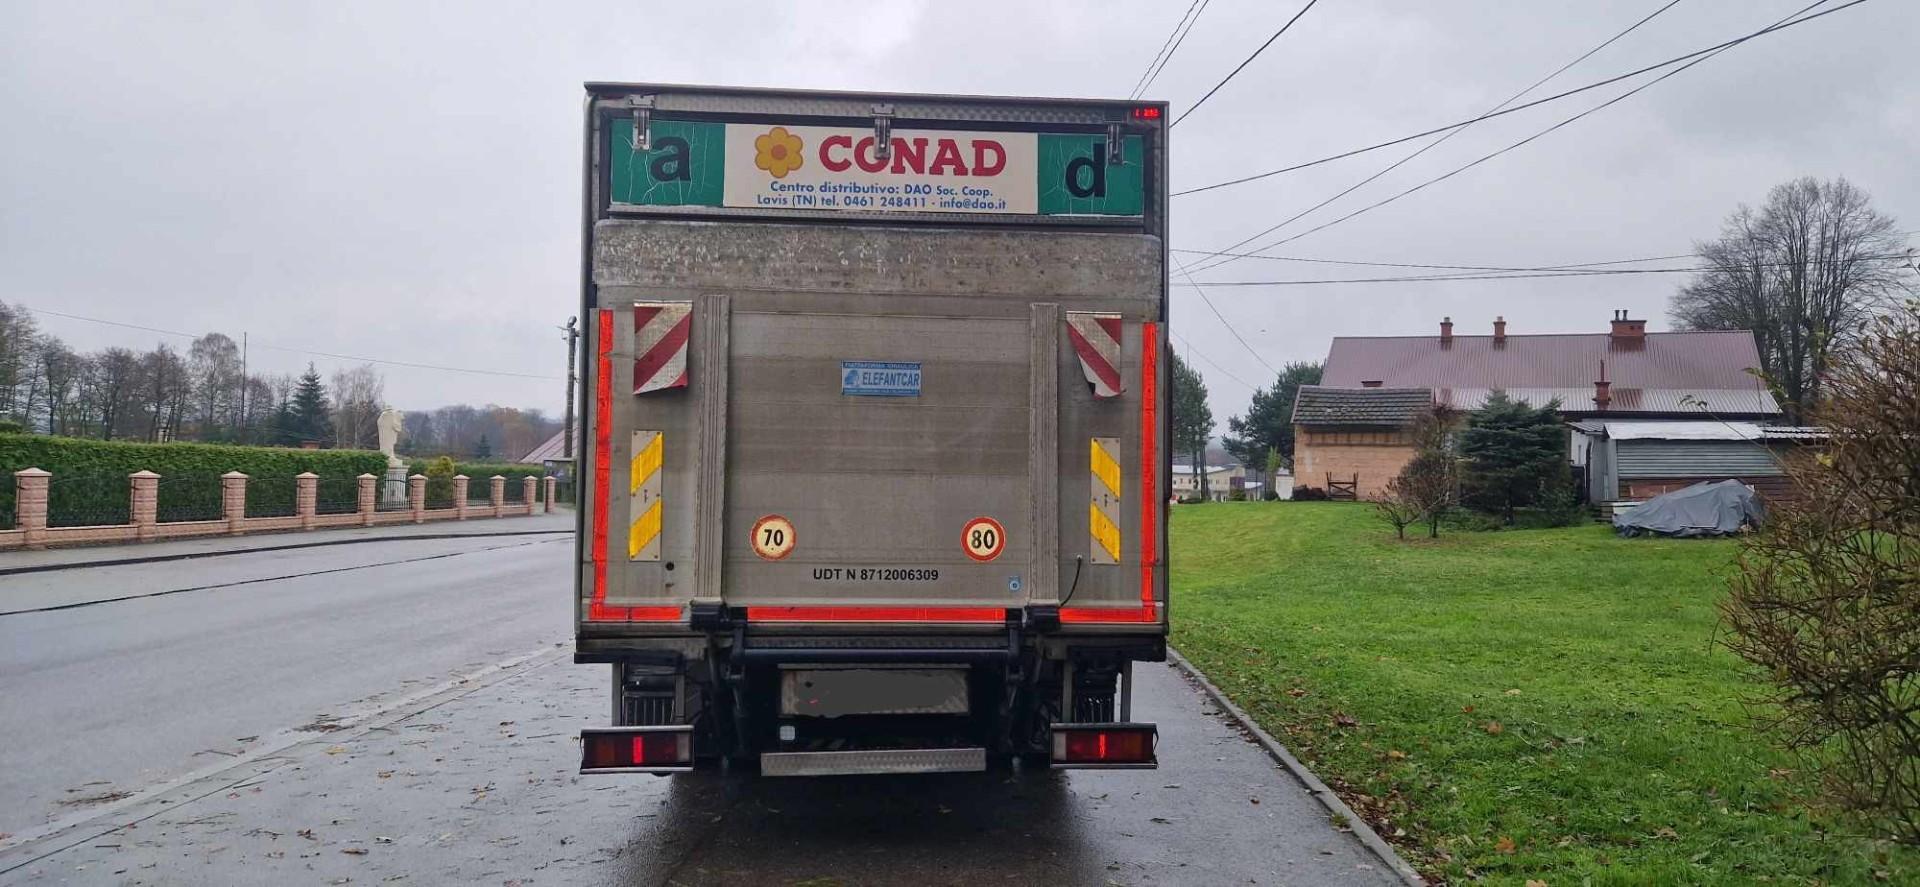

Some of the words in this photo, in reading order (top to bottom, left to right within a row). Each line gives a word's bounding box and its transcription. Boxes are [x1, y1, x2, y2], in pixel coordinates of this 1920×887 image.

[650, 136, 692, 182] a
[818, 135, 1007, 177] CONAD
[1065, 142, 1106, 198] d
[770, 180, 815, 193] Centro
[819, 181, 900, 196] distributivo:
[904, 183, 933, 195] DAO
[936, 185, 958, 196] Soc.
[962, 186, 993, 199] Coop.
[757, 193, 788, 205] Lavis
[792, 194, 817, 208] (TN)
[821, 195, 840, 207] tel.
[844, 196, 874, 207] 0461
[880, 197, 926, 207] 248411
[940, 197, 1007, 210] info@dao.it
[862, 372, 920, 387] ELEFANTCAR
[764, 528, 785, 547] 70
[971, 529, 996, 550] 80
[813, 568, 842, 580] UDT
[846, 568, 857, 580] N
[860, 569, 939, 581] 8712006309
